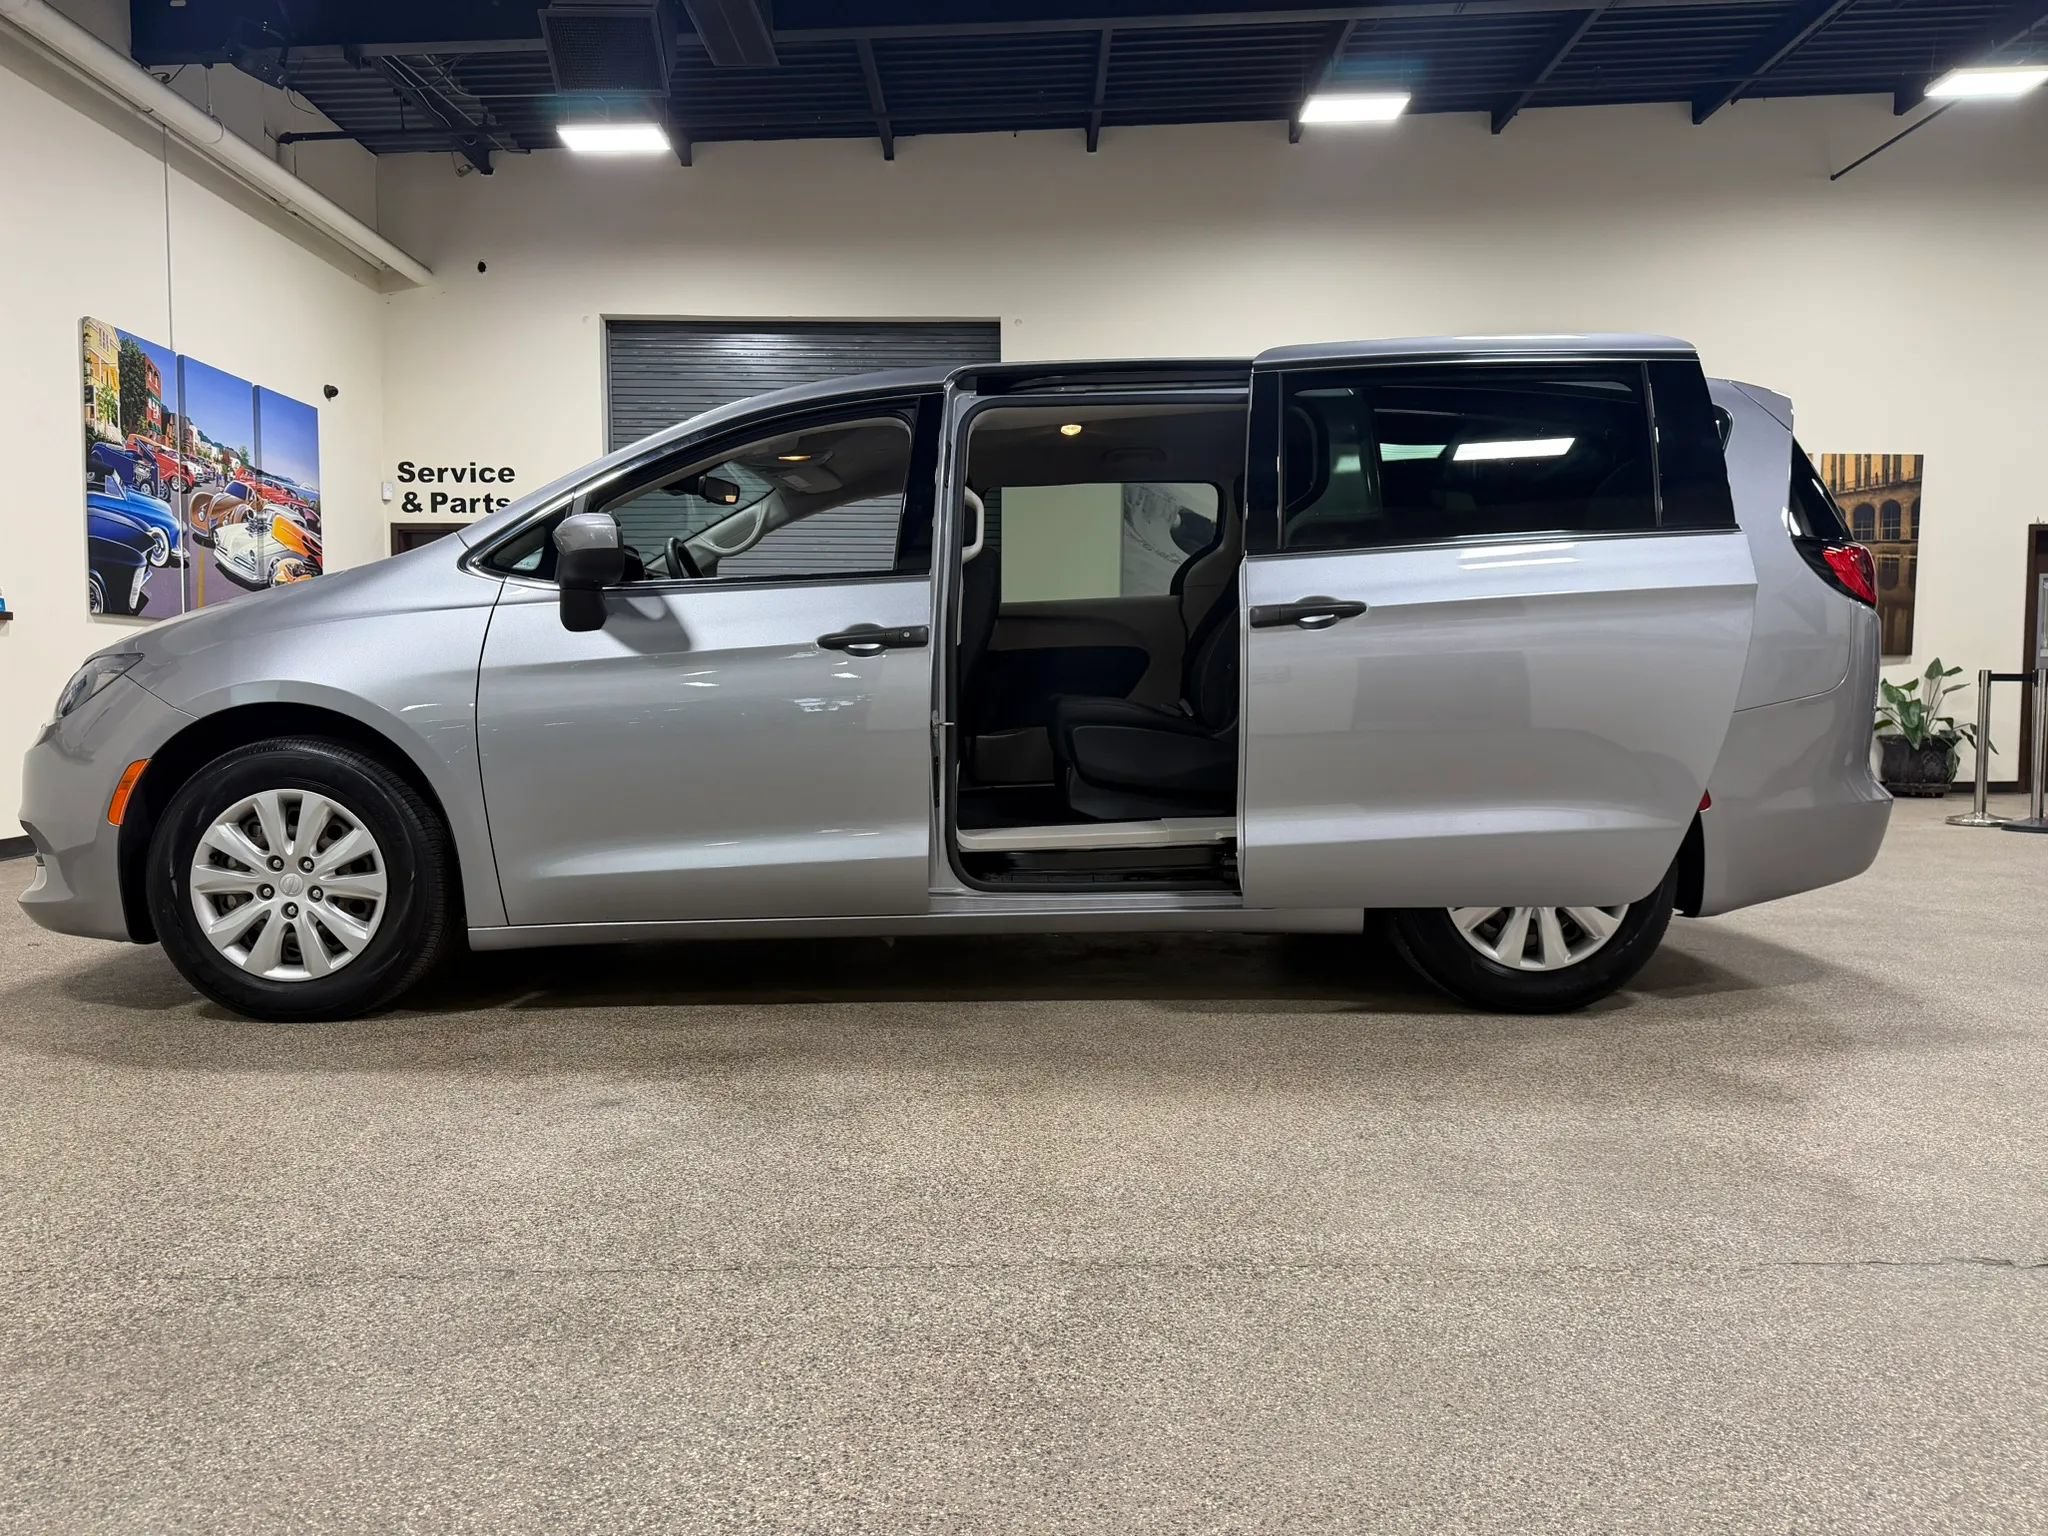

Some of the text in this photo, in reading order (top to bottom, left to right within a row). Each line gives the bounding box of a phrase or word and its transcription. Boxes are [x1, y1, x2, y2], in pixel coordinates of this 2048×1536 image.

[397, 461, 515, 483] Service
[401, 491, 511, 513] & Parts
